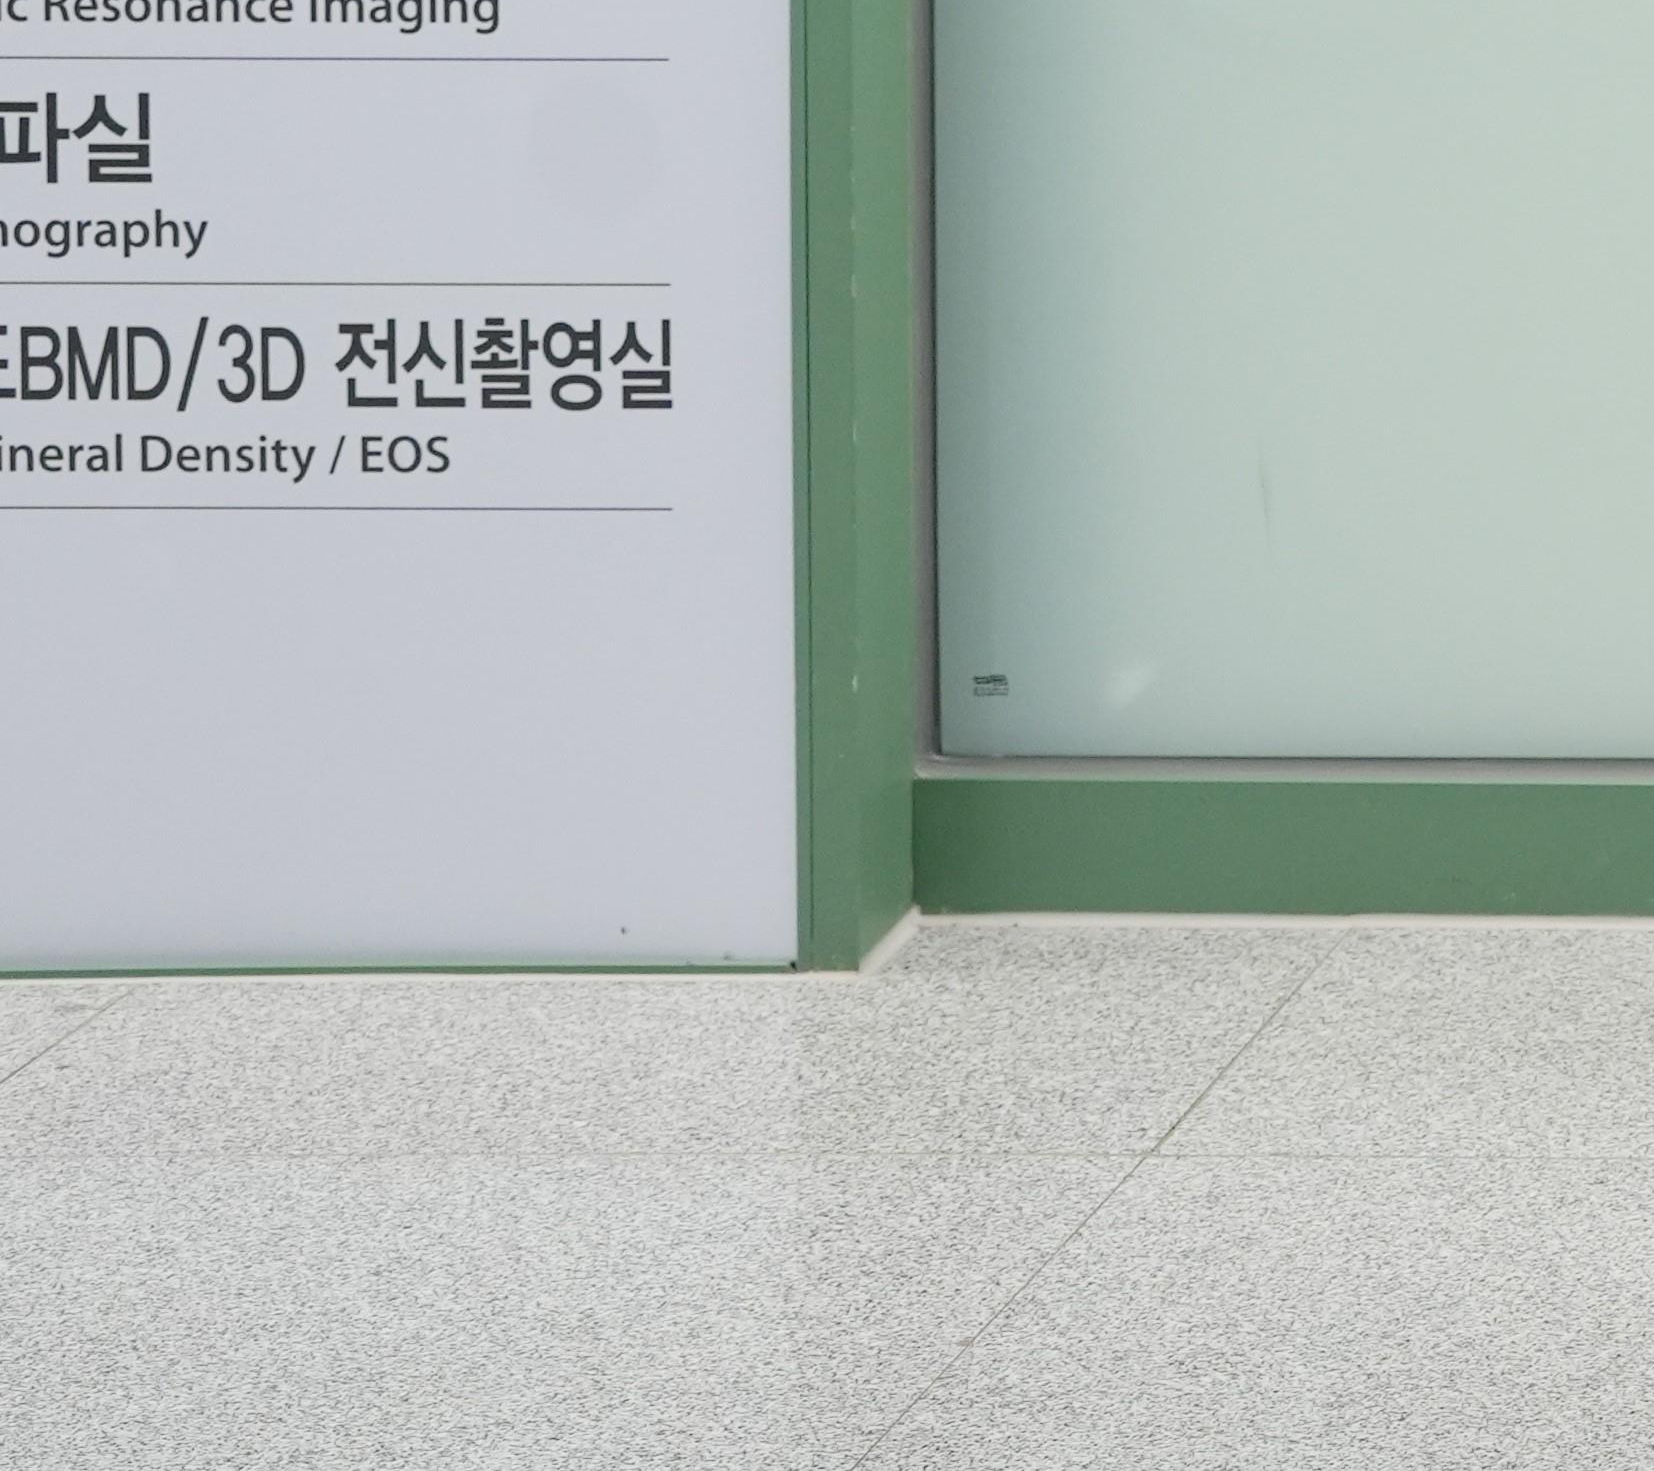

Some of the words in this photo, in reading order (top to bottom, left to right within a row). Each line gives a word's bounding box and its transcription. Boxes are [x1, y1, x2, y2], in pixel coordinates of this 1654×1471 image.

[0, 92, 152, 183] 파실
[335, 318, 672, 411] 전신촬영실
[141, 436, 315, 483] Density
[330, 436, 345, 474] /
[362, 436, 449, 473] EOS
